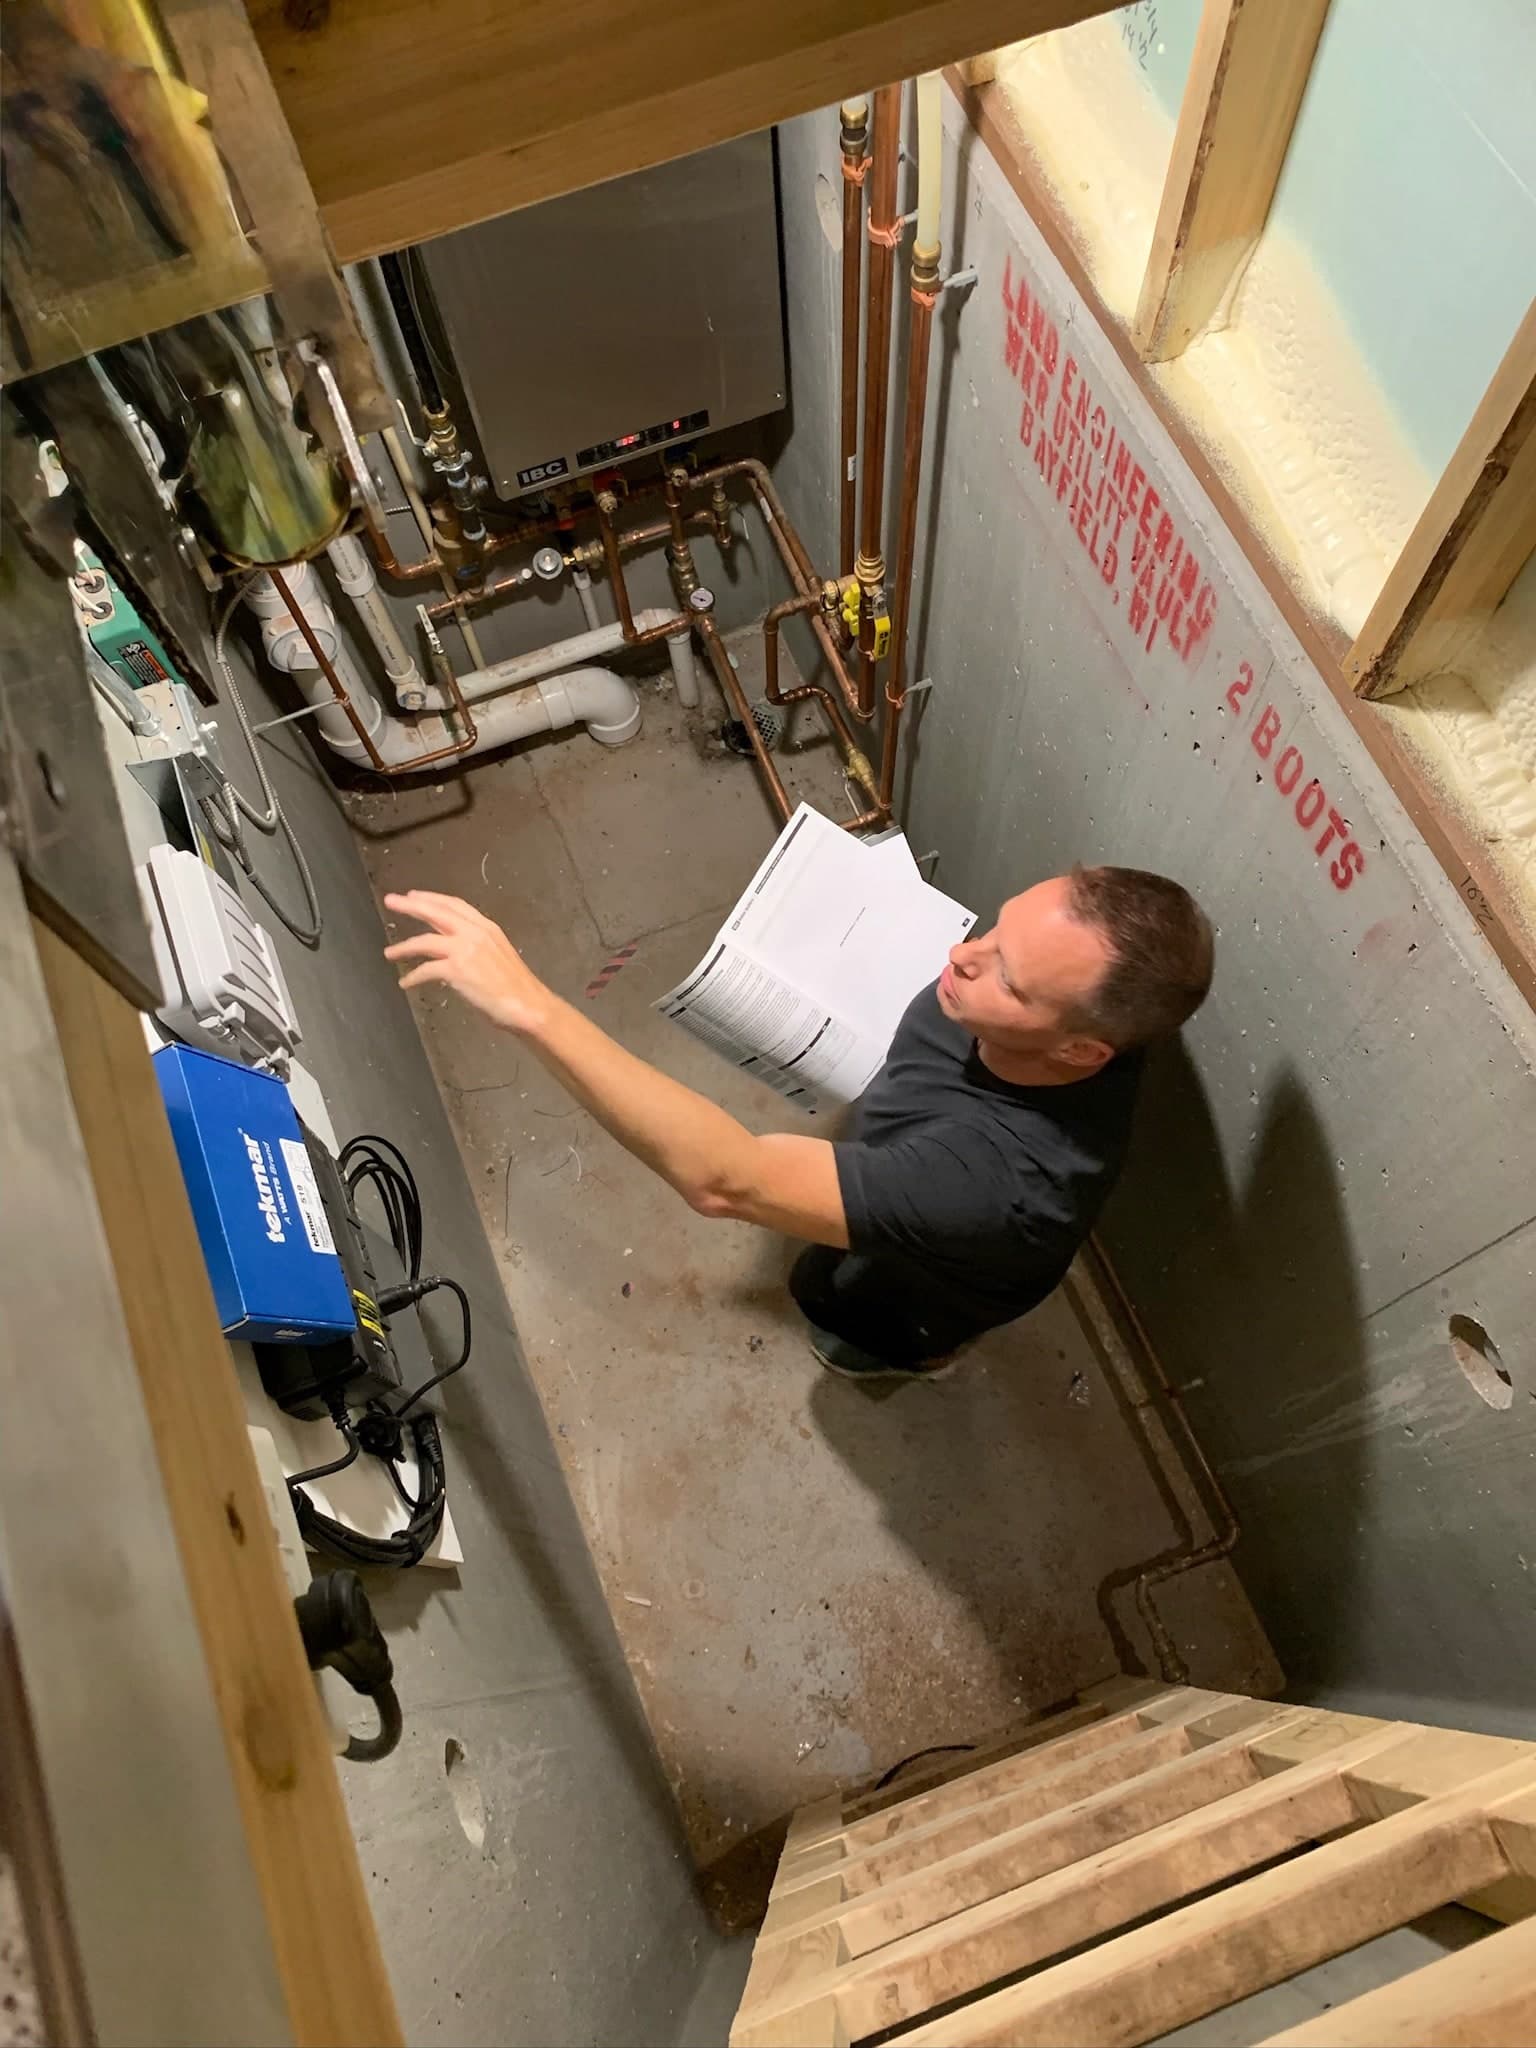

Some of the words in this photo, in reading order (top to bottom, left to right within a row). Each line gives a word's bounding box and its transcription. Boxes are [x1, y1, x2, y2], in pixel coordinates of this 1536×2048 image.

[521, 461, 563, 484] IBC
[1020, 401, 1120, 606] BAYFIELD,
[1128, 584, 1159, 654] WI
[1053, 400, 1129, 543] UTILITY
[1131, 529, 1203, 662] VAULT
[1060, 353, 1217, 631] ENGINEERING
[1226, 661, 1254, 717] 2
[1251, 704, 1366, 890] BOOTS
[243, 1132, 286, 1243] tekmar
[262, 1140, 278, 1176] Brand
[305, 1210, 320, 1248] tekmar
